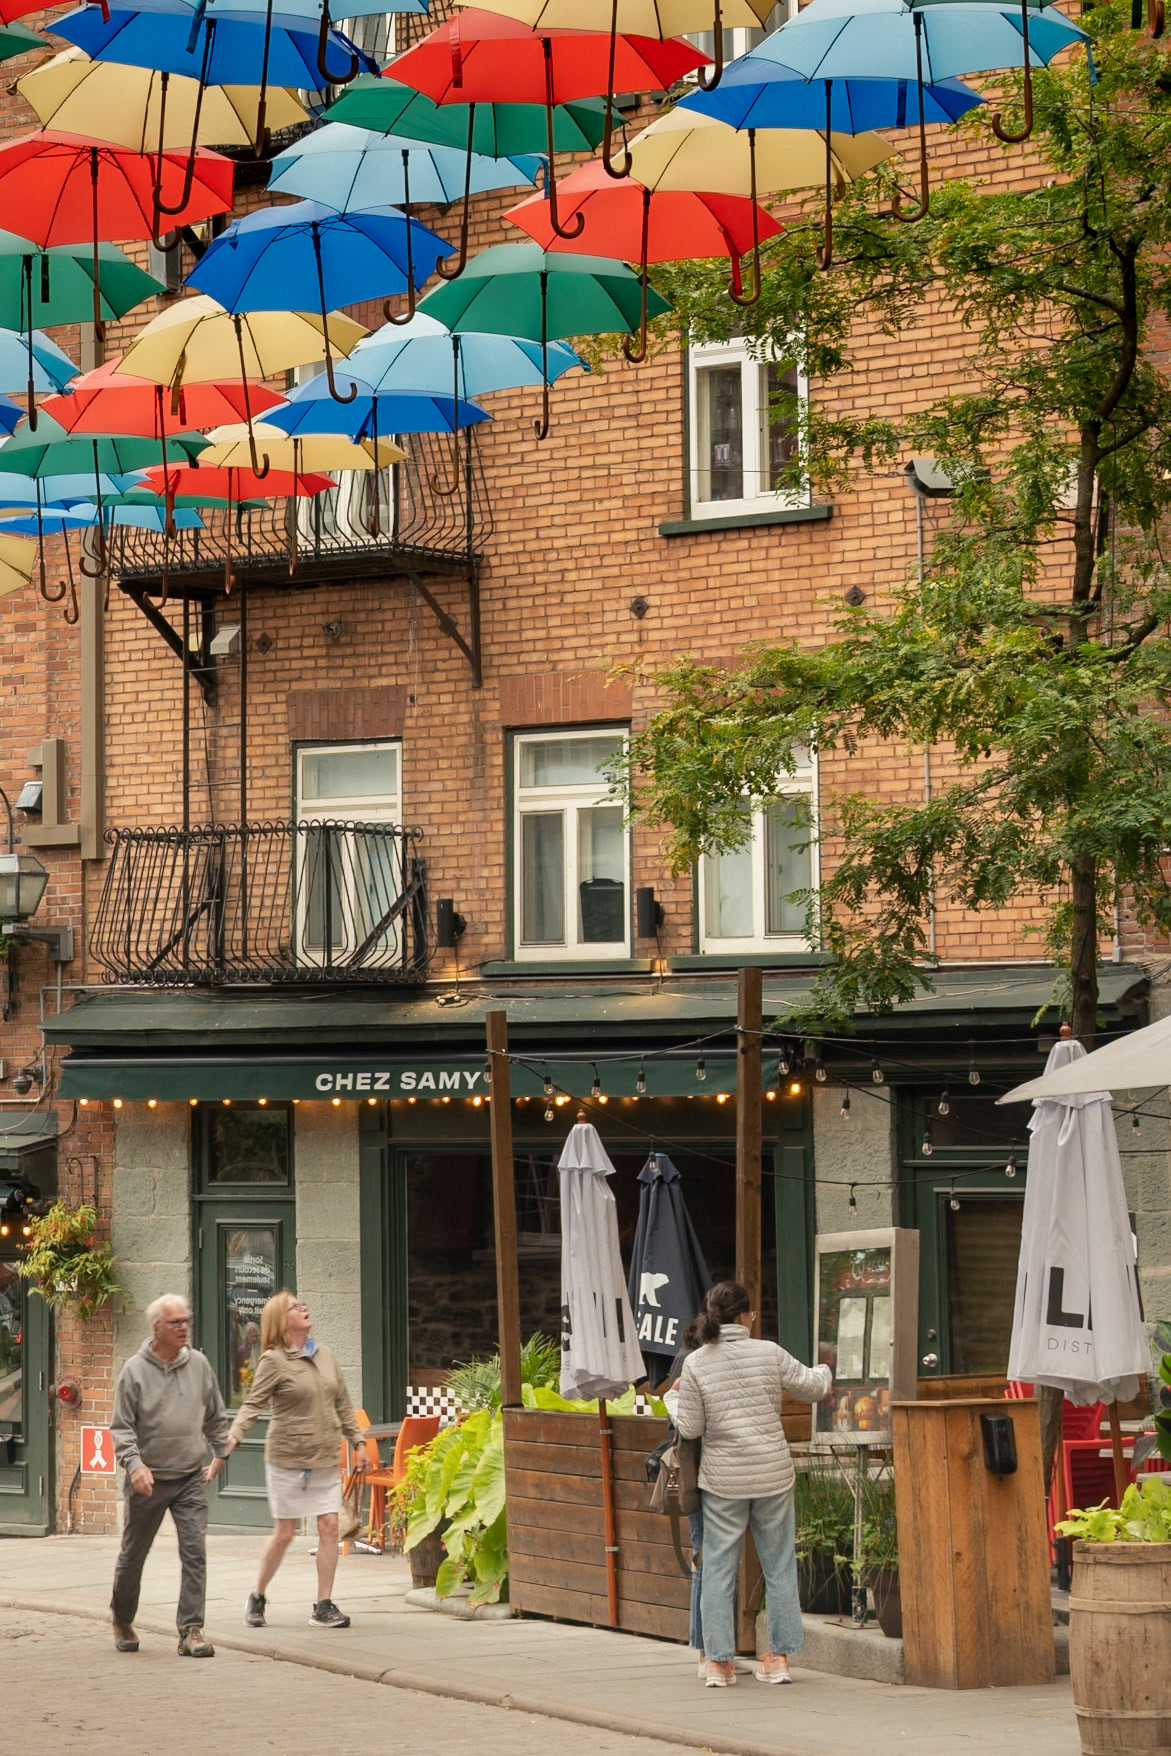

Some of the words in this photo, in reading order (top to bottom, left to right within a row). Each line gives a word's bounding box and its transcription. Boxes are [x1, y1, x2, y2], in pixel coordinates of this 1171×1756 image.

[315, 1072, 391, 1091] CHEZ
[400, 1071, 481, 1090] SAMY
[1047, 1266, 1093, 1331] L
[635, 1311, 679, 1346] ALE
